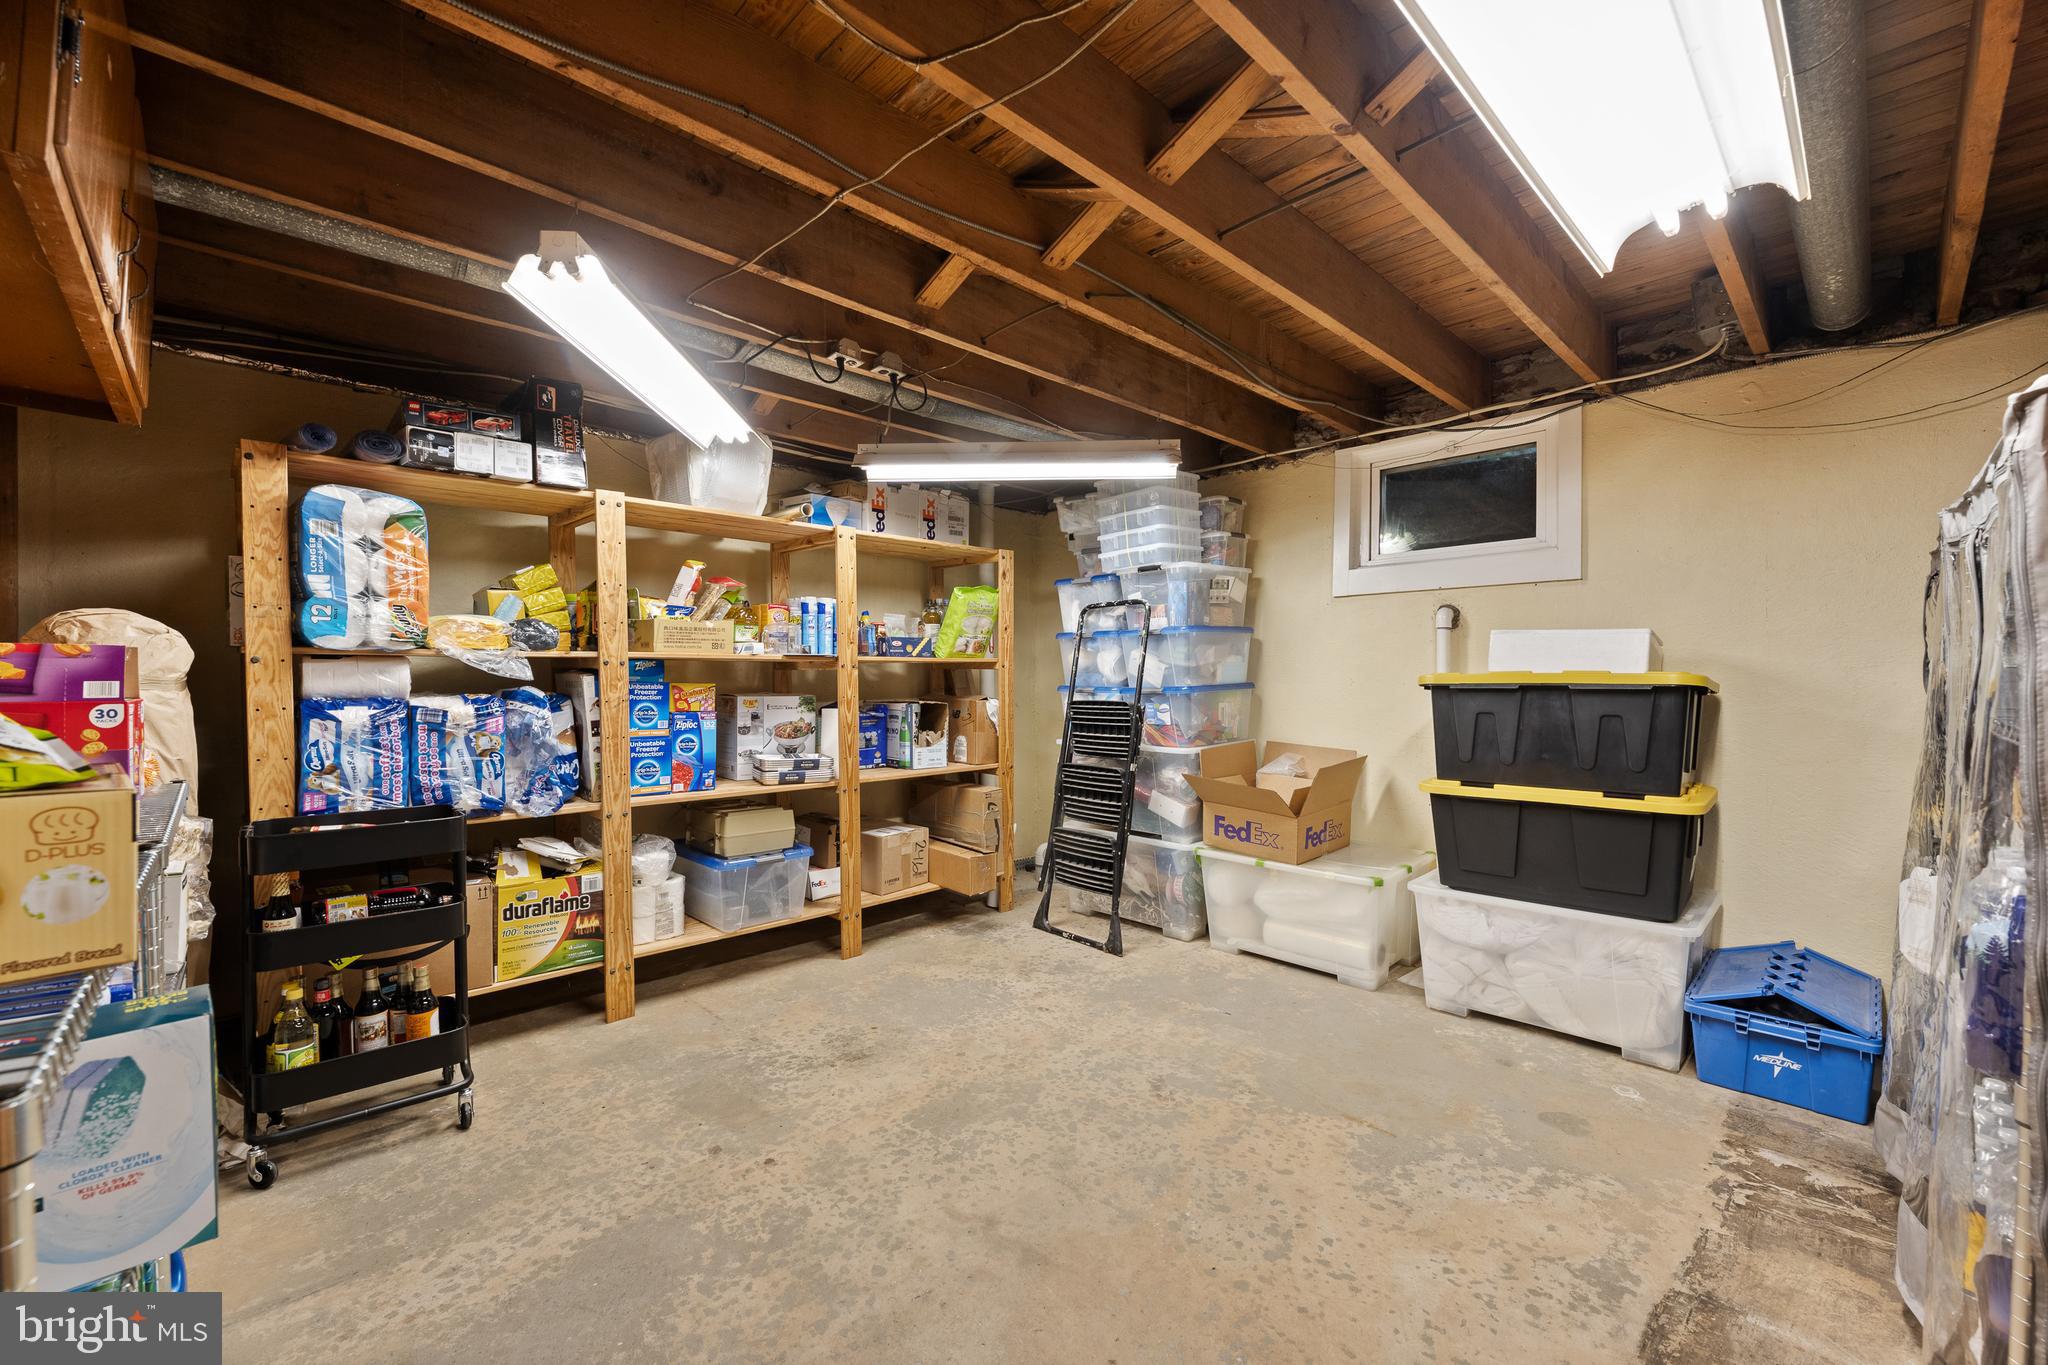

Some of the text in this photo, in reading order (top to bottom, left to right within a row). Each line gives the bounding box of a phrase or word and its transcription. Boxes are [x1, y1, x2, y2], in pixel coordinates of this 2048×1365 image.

[563, 415, 574, 453] TRAVEL
[872, 487, 886, 532] edEx
[922, 498, 936, 540] edEx
[309, 537, 318, 572] LONGER
[310, 604, 332, 624] 12
[635, 661, 656, 670] Ziploc
[95, 708, 118, 719] 30
[676, 720, 698, 729] Ziploc
[417, 724, 428, 754] most
[382, 780, 390, 796] OUR
[392, 774, 403, 802] most
[1214, 815, 1280, 849] FedEx
[1304, 819, 1344, 850] FedEx
[25, 842, 106, 862] D-PLUS
[502, 894, 590, 922] duraflame
[524, 920, 560, 930] Renewable
[524, 926, 557, 936] Resources
[0, 944, 122, 974] Flavored Bread
[1753, 1054, 1802, 1070] MEDLINE
[58, 1154, 162, 1190] CLOROX CLEANER
[71, 1152, 150, 1179] LOADED WITH
[77, 1181, 108, 1196] KILLS
[81, 1180, 138, 1200] OF GERMS
